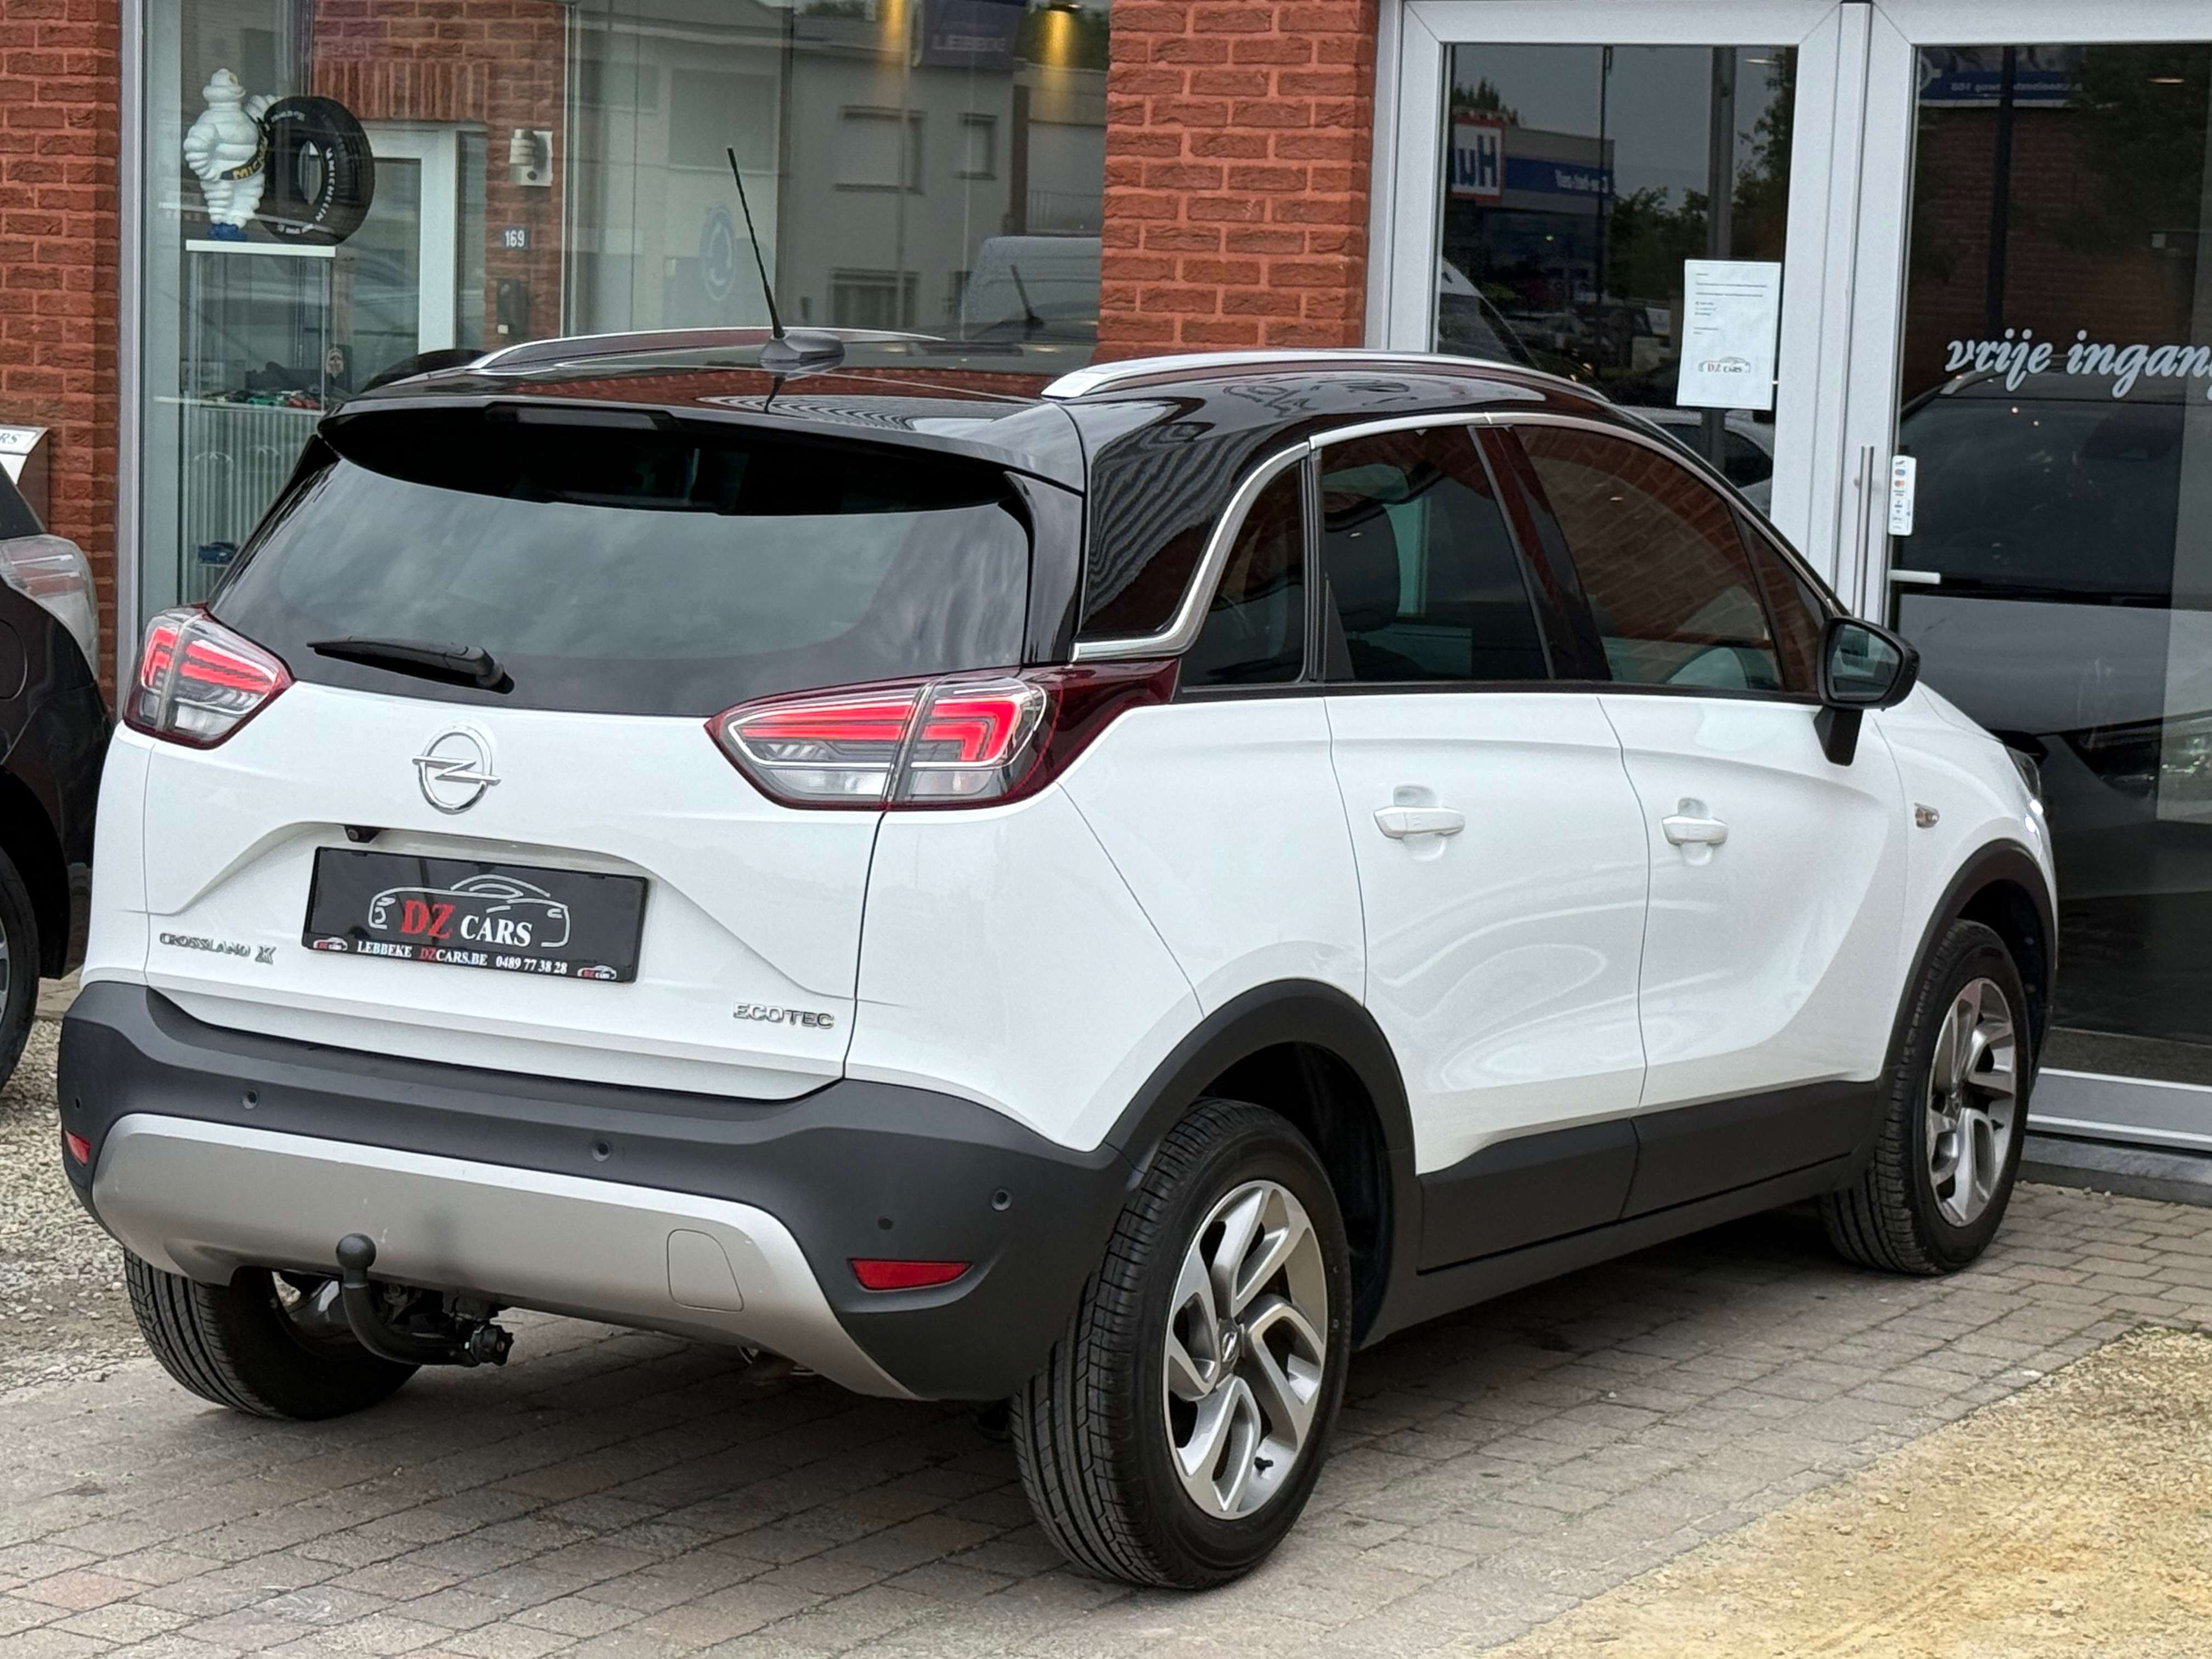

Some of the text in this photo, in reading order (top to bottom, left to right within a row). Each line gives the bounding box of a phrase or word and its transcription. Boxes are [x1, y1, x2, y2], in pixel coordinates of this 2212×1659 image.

[314, 159, 336, 222] MICHELIN
[505, 230, 525, 247] 169
[1945, 328, 2212, 402] vrije ingan
[0, 432, 18, 444] RS
[400, 899, 533, 947] DZ CARS
[254, 945, 276, 966] X
[357, 940, 413, 958] LEBBEKE
[419, 947, 488, 967] DZCARS.BE
[495, 955, 521, 970] 0489
[523, 958, 537, 972] 77
[538, 961, 551, 973] 38
[553, 961, 568, 975] 28
[733, 1003, 835, 1030] ECOTEC
